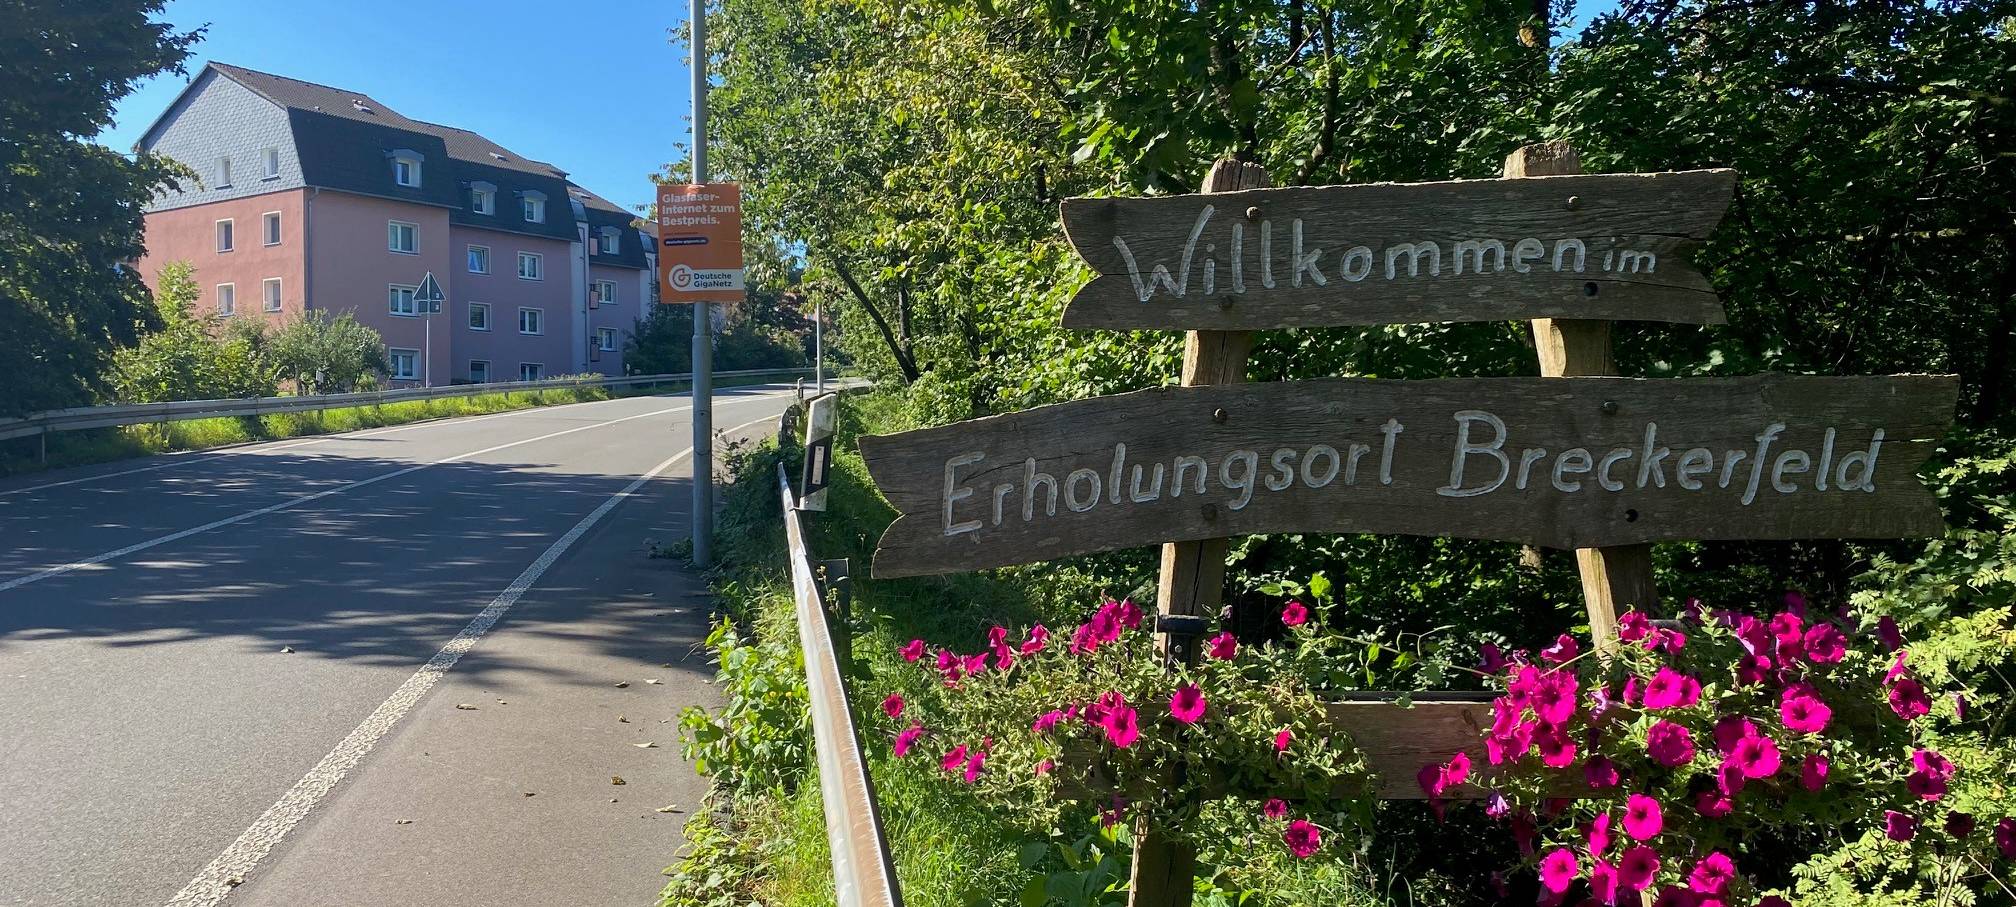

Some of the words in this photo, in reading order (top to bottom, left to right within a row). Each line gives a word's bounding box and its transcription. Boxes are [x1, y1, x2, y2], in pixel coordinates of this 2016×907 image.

[662, 192, 720, 203] Glasfaser-
[662, 204, 706, 214] Internet
[710, 205, 735, 213] zum
[662, 215, 720, 226] Bestpreis.
[1113, 204, 1587, 300] Willkommen
[1603, 238, 1657, 275] im
[693, 280, 732, 288] GigaNetz
[942, 418, 1404, 536] Erholungsort
[1436, 409, 1885, 506] Breckerfeld
